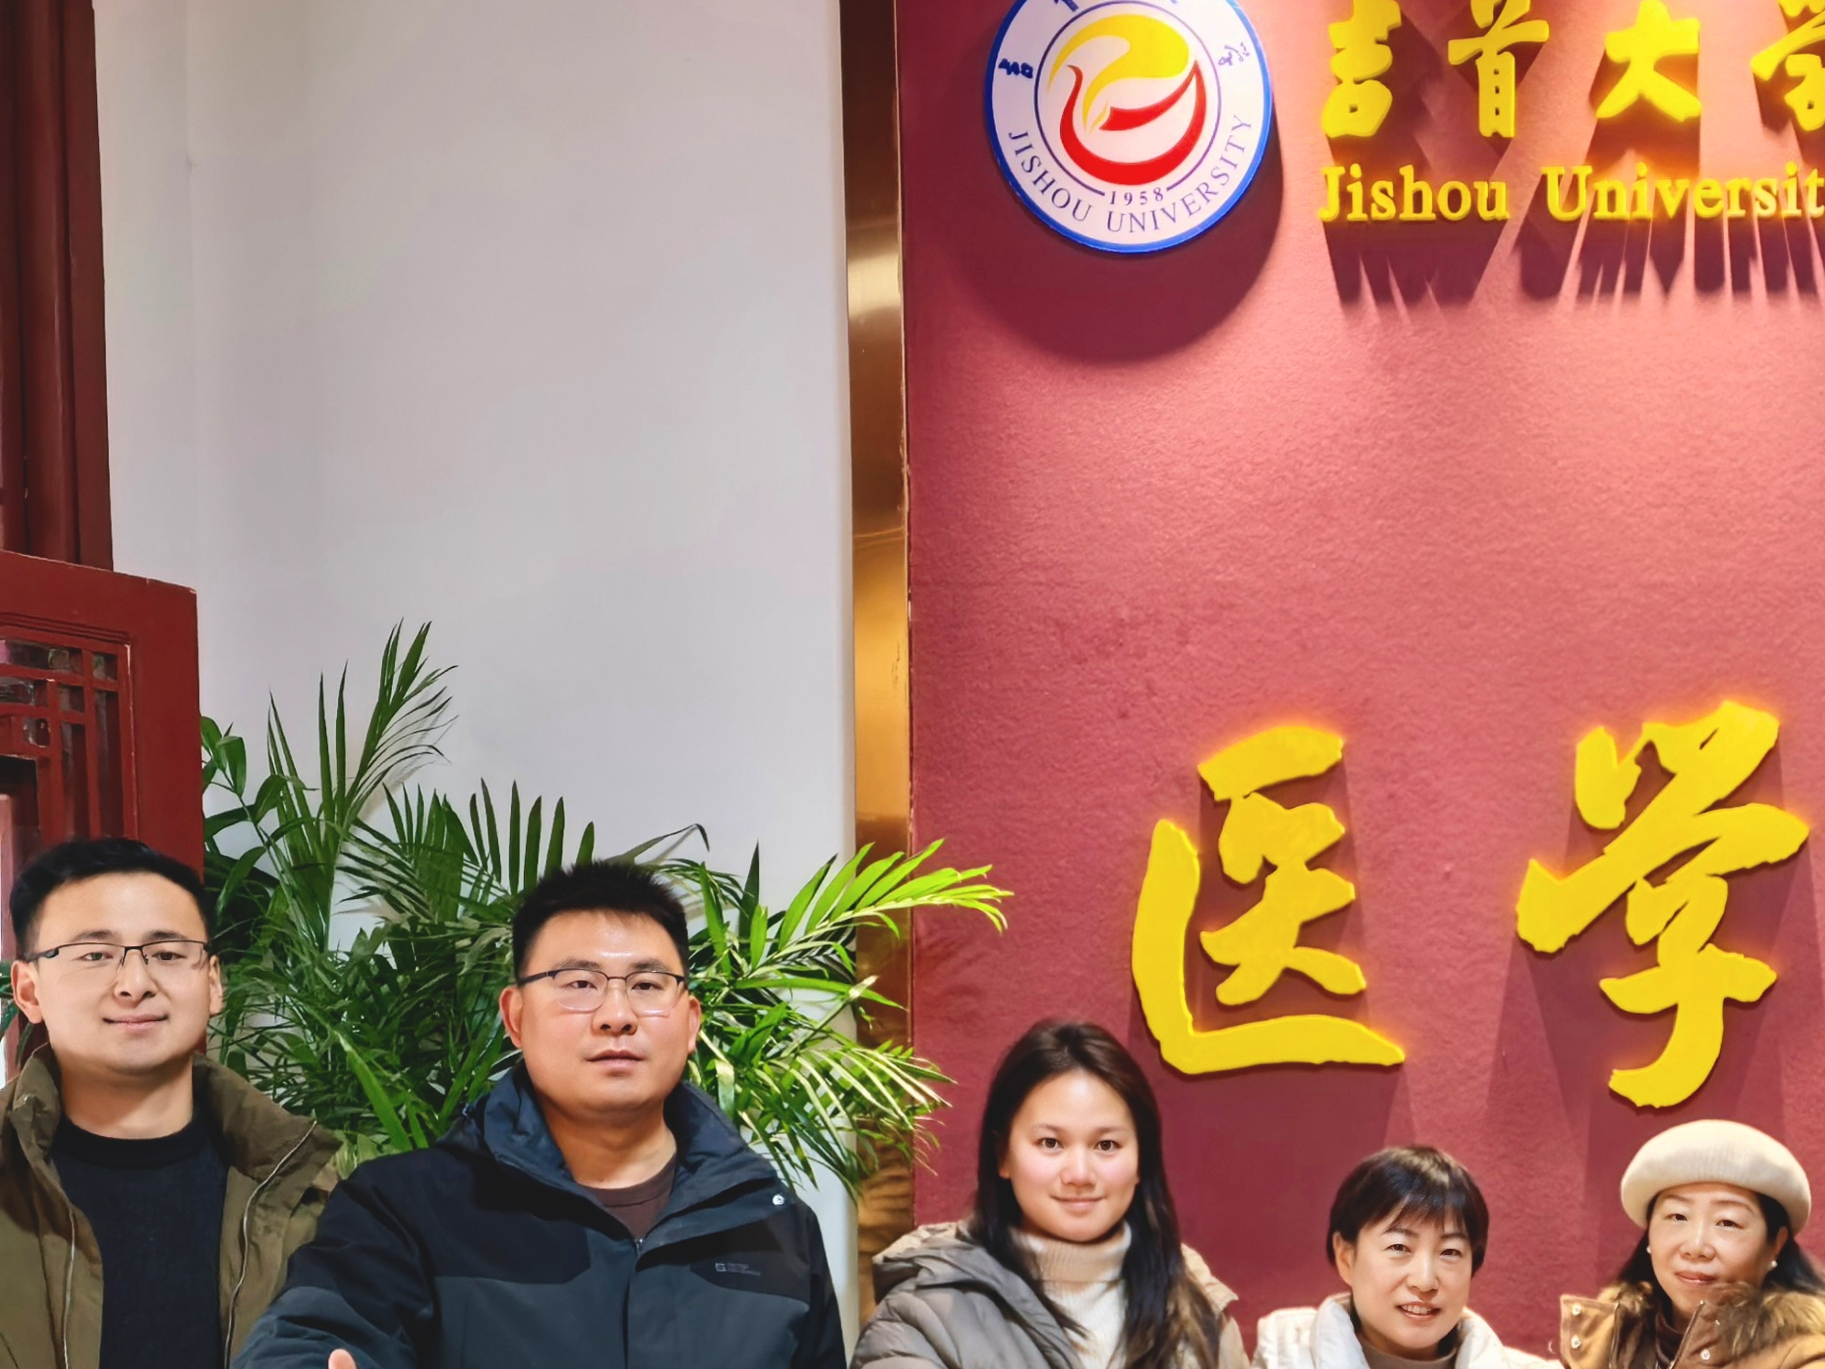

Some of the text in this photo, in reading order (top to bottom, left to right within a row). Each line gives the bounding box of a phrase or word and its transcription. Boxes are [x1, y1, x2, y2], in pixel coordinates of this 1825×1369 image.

[1008, 114, 1252, 233] JISHOU UNIVERSITY
[1109, 187, 1164, 206] 1958
[1319, 163, 1510, 222] Jishou
